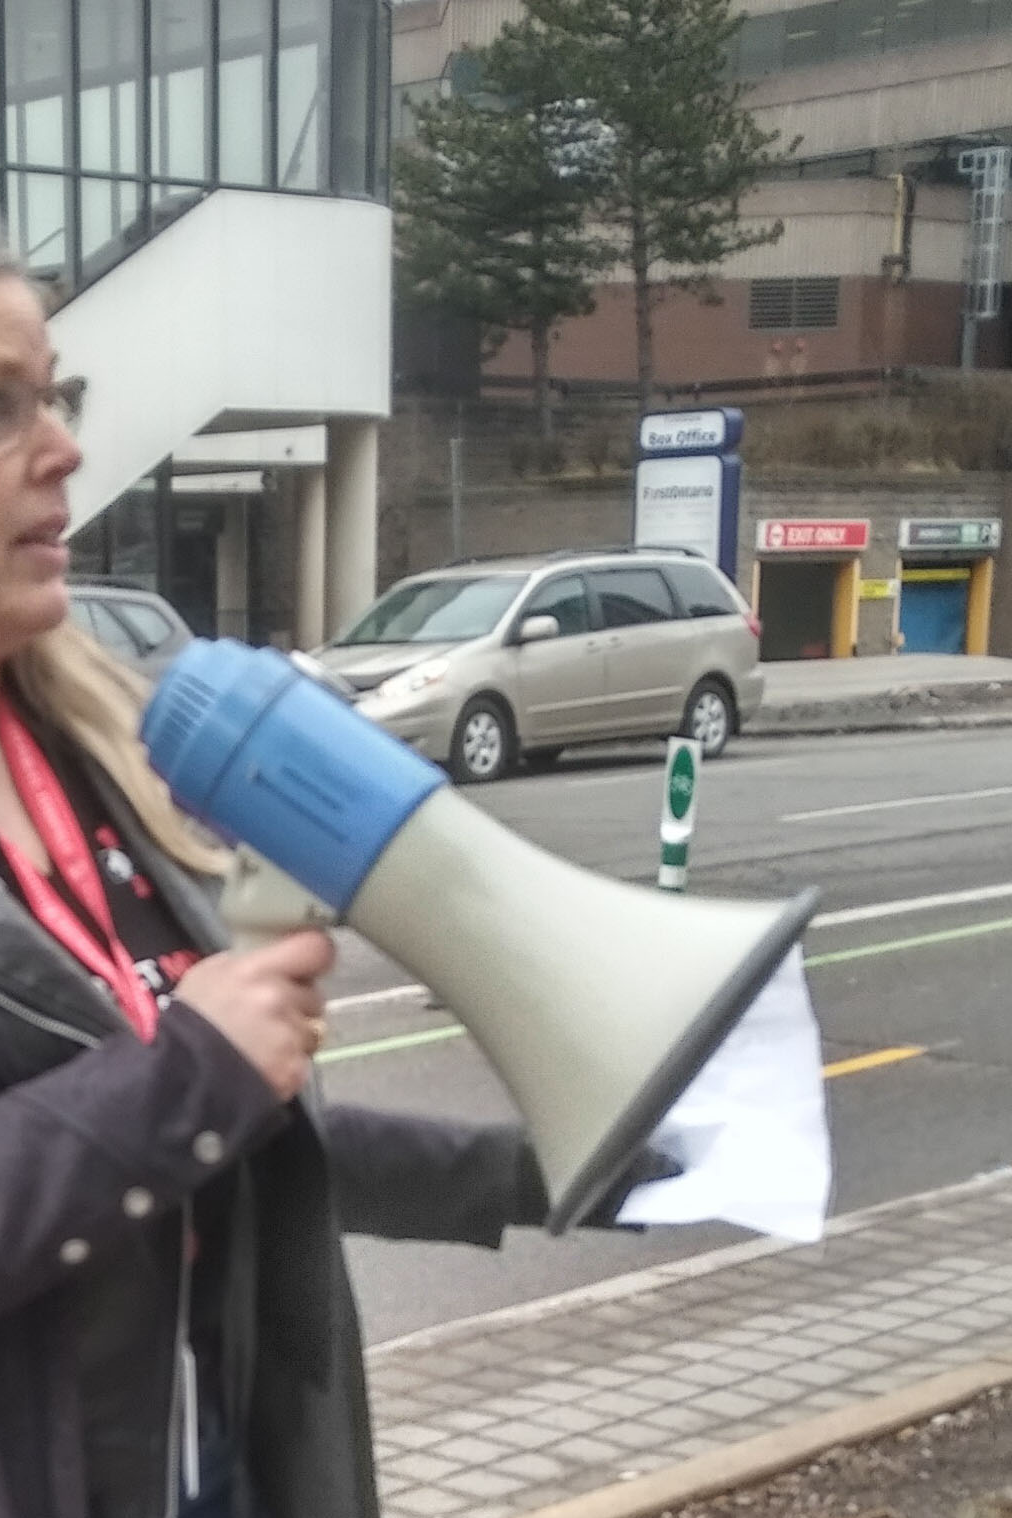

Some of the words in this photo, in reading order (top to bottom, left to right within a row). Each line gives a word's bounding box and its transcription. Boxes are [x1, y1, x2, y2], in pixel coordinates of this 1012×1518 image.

[649, 431, 672, 445] Box
[676, 428, 716, 446] Office
[787, 526, 814, 544] EXIT
[815, 526, 846, 544] ONLY
